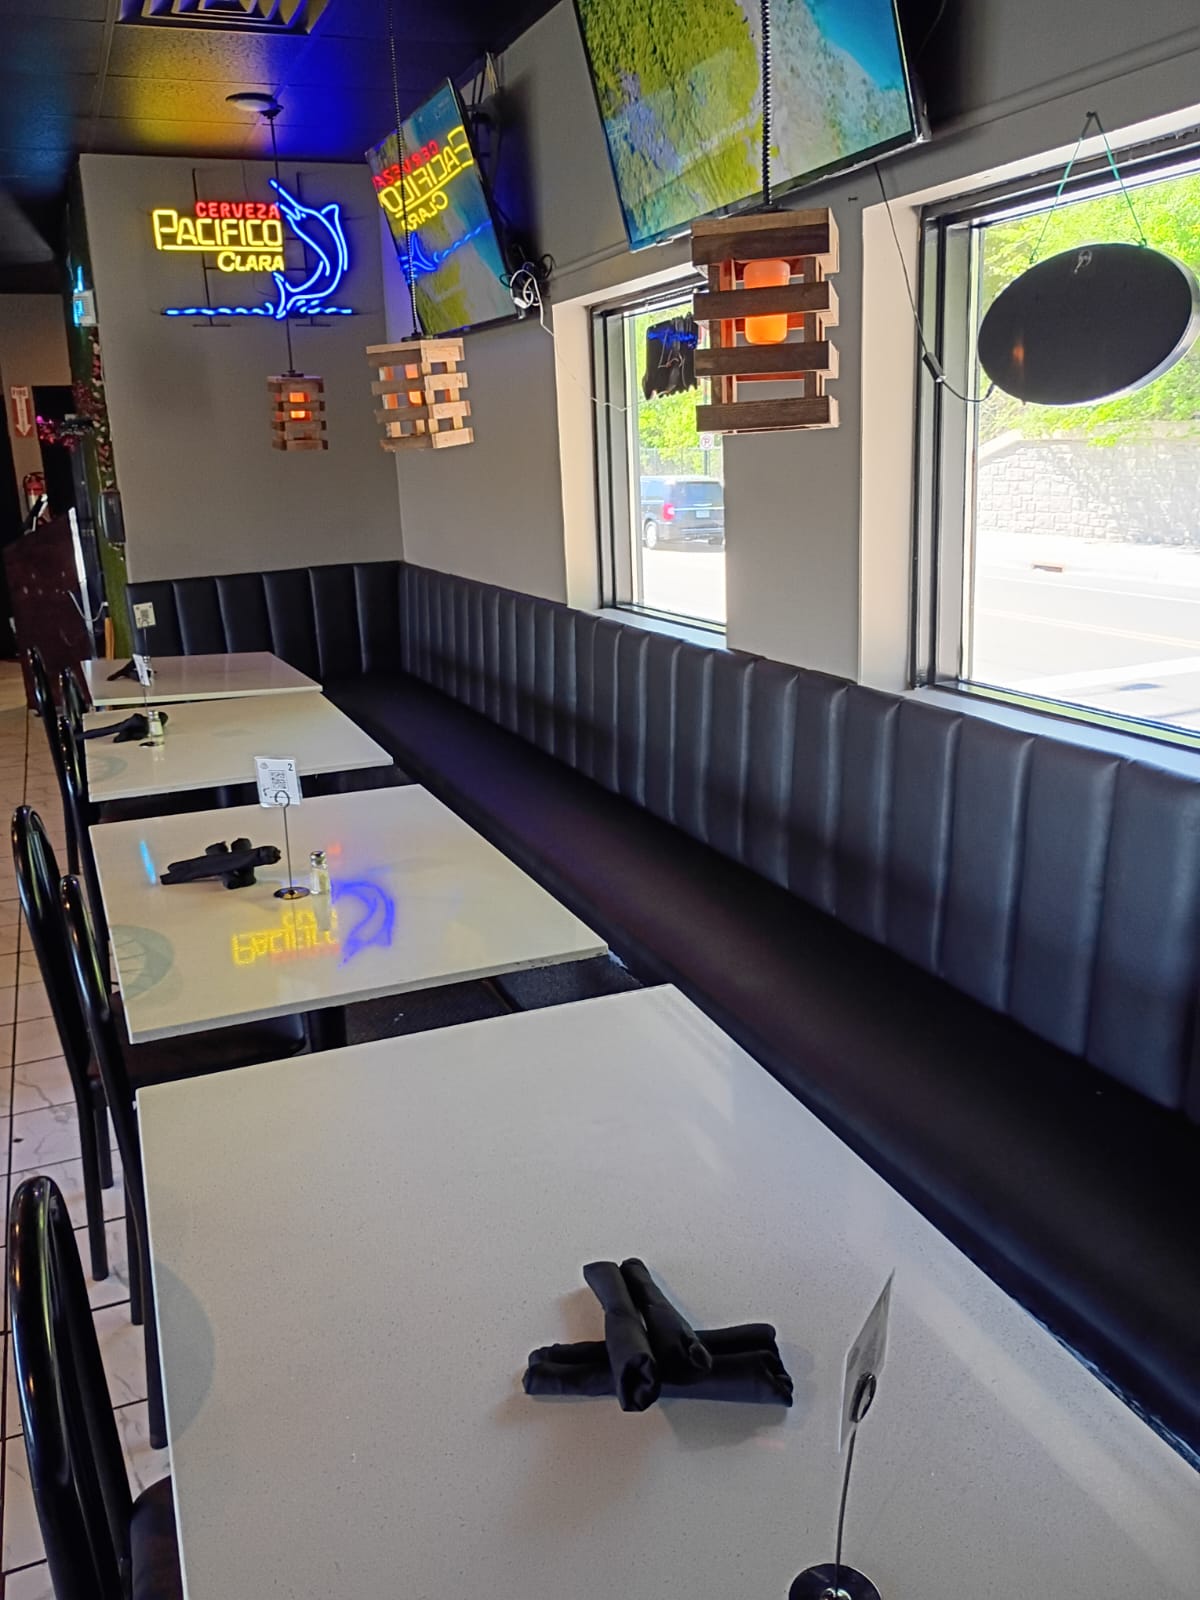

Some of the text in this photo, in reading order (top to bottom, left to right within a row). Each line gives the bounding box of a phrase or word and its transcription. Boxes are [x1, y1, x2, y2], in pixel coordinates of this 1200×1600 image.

[195, 201, 281, 219] CERVEZA
[152, 209, 284, 250] PACIFICO
[217, 251, 285, 272] CLARA
[287, 762, 294, 772] 2
